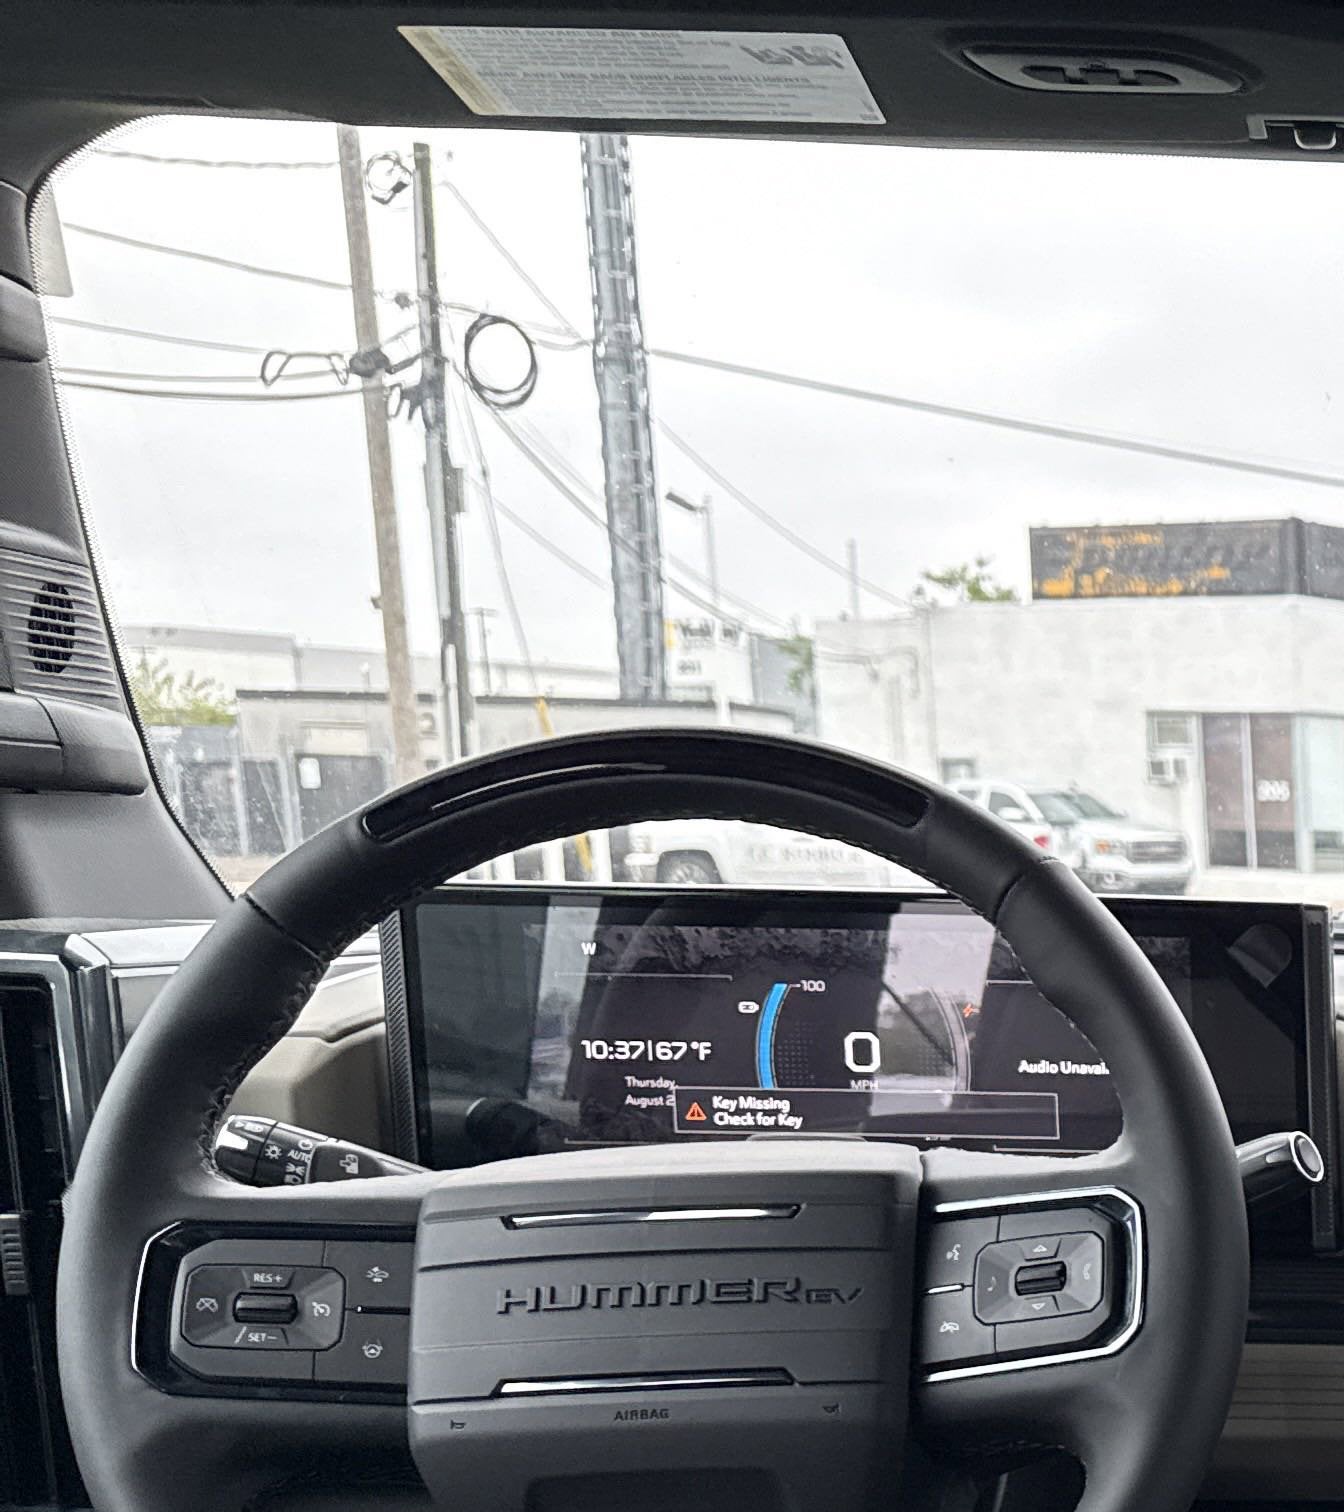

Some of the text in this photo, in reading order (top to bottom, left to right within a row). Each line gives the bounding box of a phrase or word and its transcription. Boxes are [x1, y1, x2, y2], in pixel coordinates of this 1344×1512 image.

[581, 943, 597, 956] W
[801, 980, 826, 992] 100
[843, 1032, 880, 1073] 0
[1018, 1061, 1058, 1074] Audio
[850, 1080, 878, 1090] MPH
[625, 1094, 664, 1108] August
[713, 1096, 790, 1112] Key Missing
[713, 1112, 803, 1130] Check for Key
[287, 1150, 312, 1163] AUTO
[497, 1277, 802, 1314] HUMMER
[614, 1408, 669, 1422] AIRBAG
